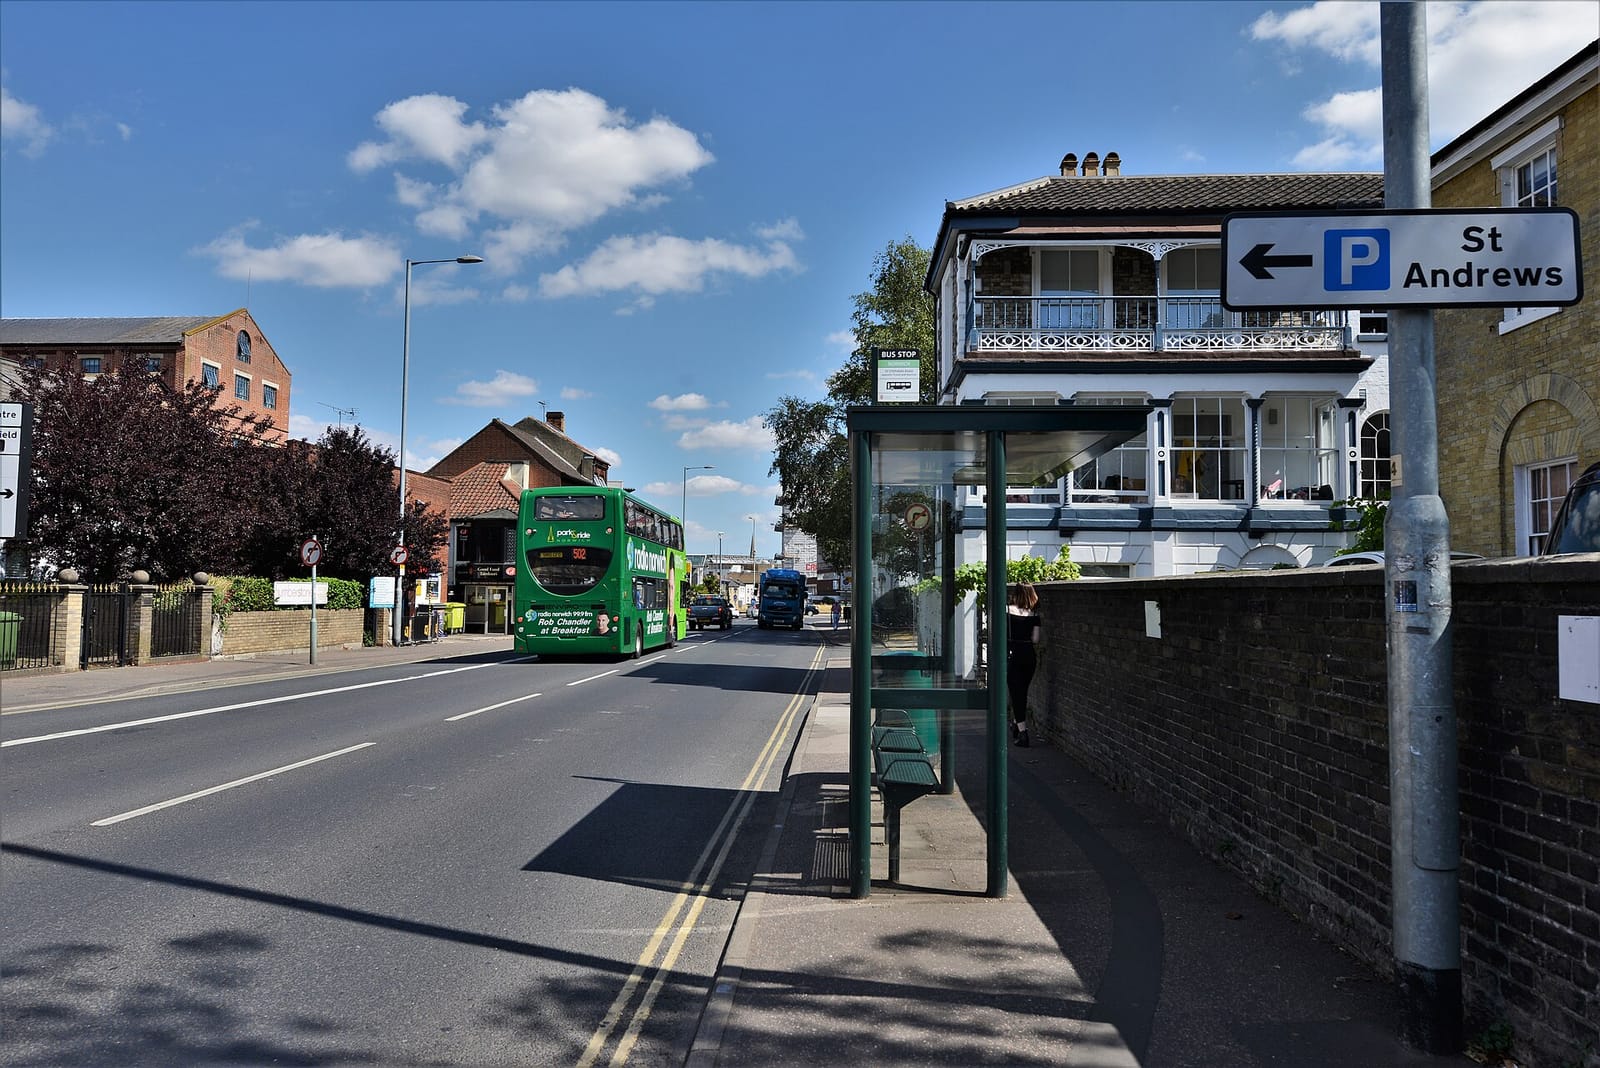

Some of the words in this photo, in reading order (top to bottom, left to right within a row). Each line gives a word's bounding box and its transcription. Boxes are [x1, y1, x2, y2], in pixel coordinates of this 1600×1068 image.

[1460, 226, 1503, 253] St
[1341, 236, 1380, 285] P
[1403, 261, 1563, 289] Andrews
[573, 548, 587, 560] 502
[634, 543, 648, 571] radio
[648, 549, 667, 573] norwich
[538, 618, 554, 626] Rob
[557, 618, 592, 626] Chandler
[540, 627, 549, 635] at
[551, 626, 590, 634] Breakfast
